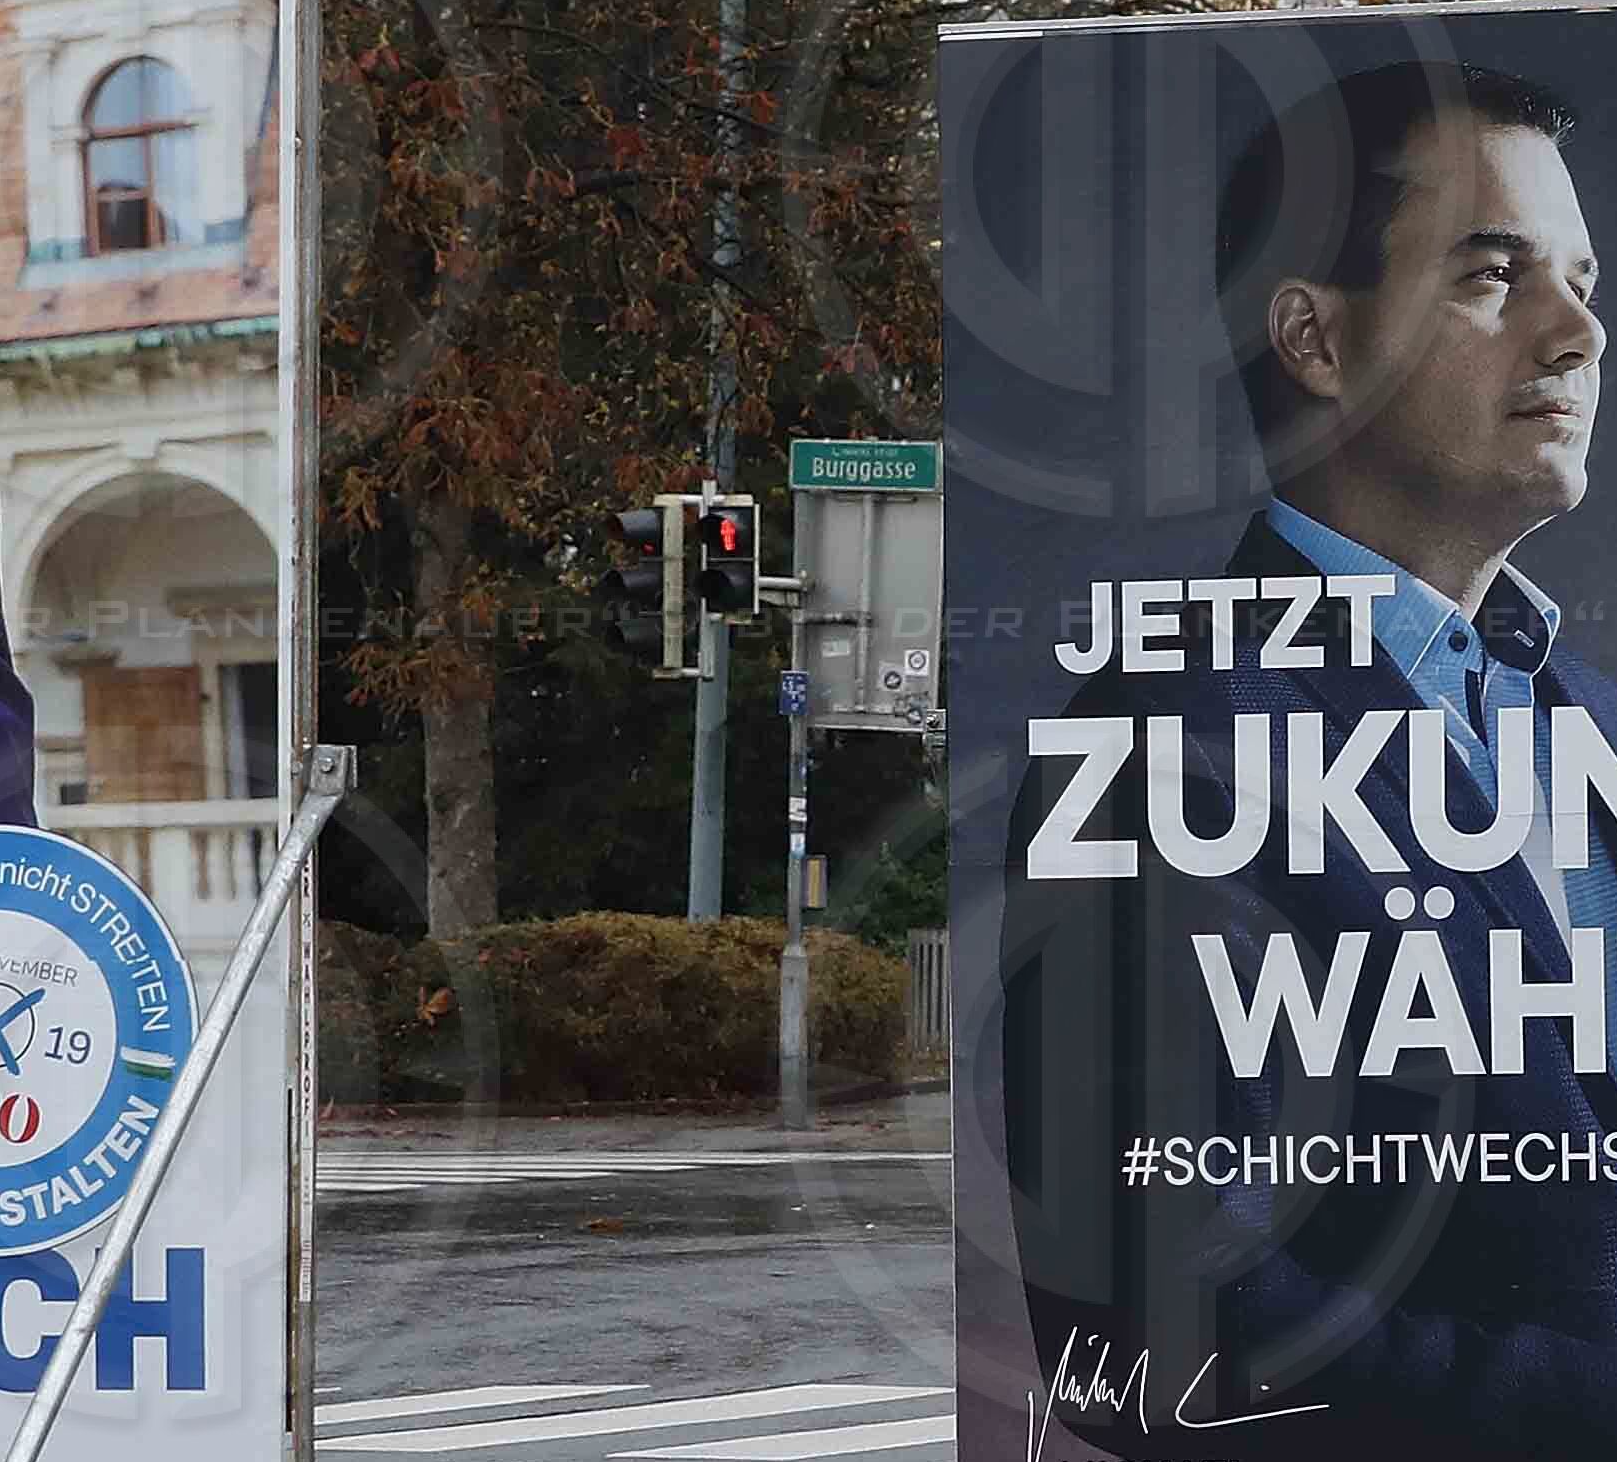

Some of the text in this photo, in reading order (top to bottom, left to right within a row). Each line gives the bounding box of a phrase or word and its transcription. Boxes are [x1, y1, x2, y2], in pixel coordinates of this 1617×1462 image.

[812, 456, 917, 483] Burggasse
[1053, 574, 1398, 676] JETZT
[70, 883, 171, 1033] STREITEN
[44, 1026, 92, 1066] 19
